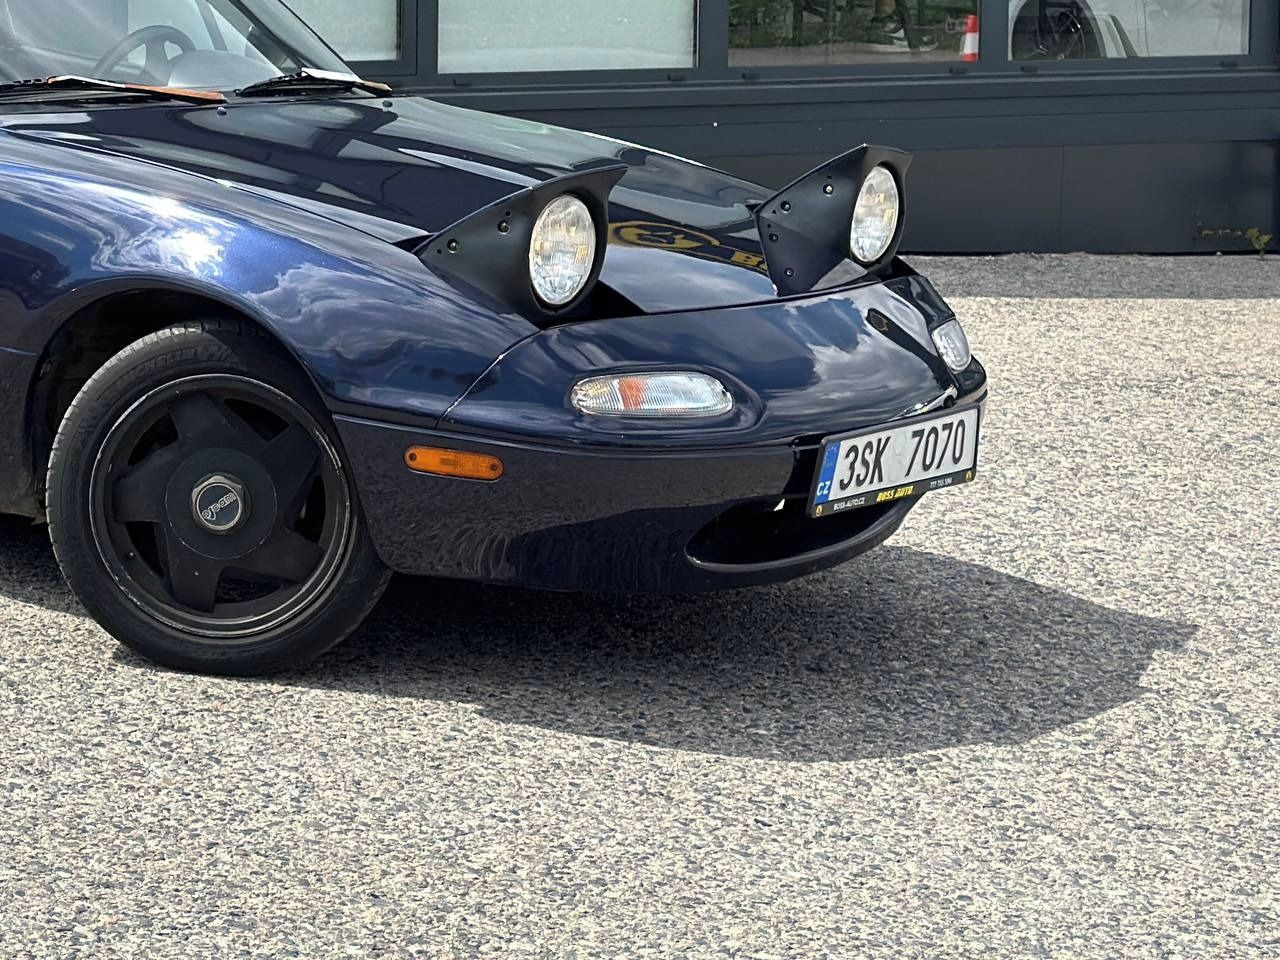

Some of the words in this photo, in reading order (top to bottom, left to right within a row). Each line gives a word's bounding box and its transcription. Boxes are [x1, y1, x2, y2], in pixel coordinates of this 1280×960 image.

[839, 435, 892, 491] 3SK
[904, 418, 966, 478] 7070
[816, 480, 831, 496] CZ
